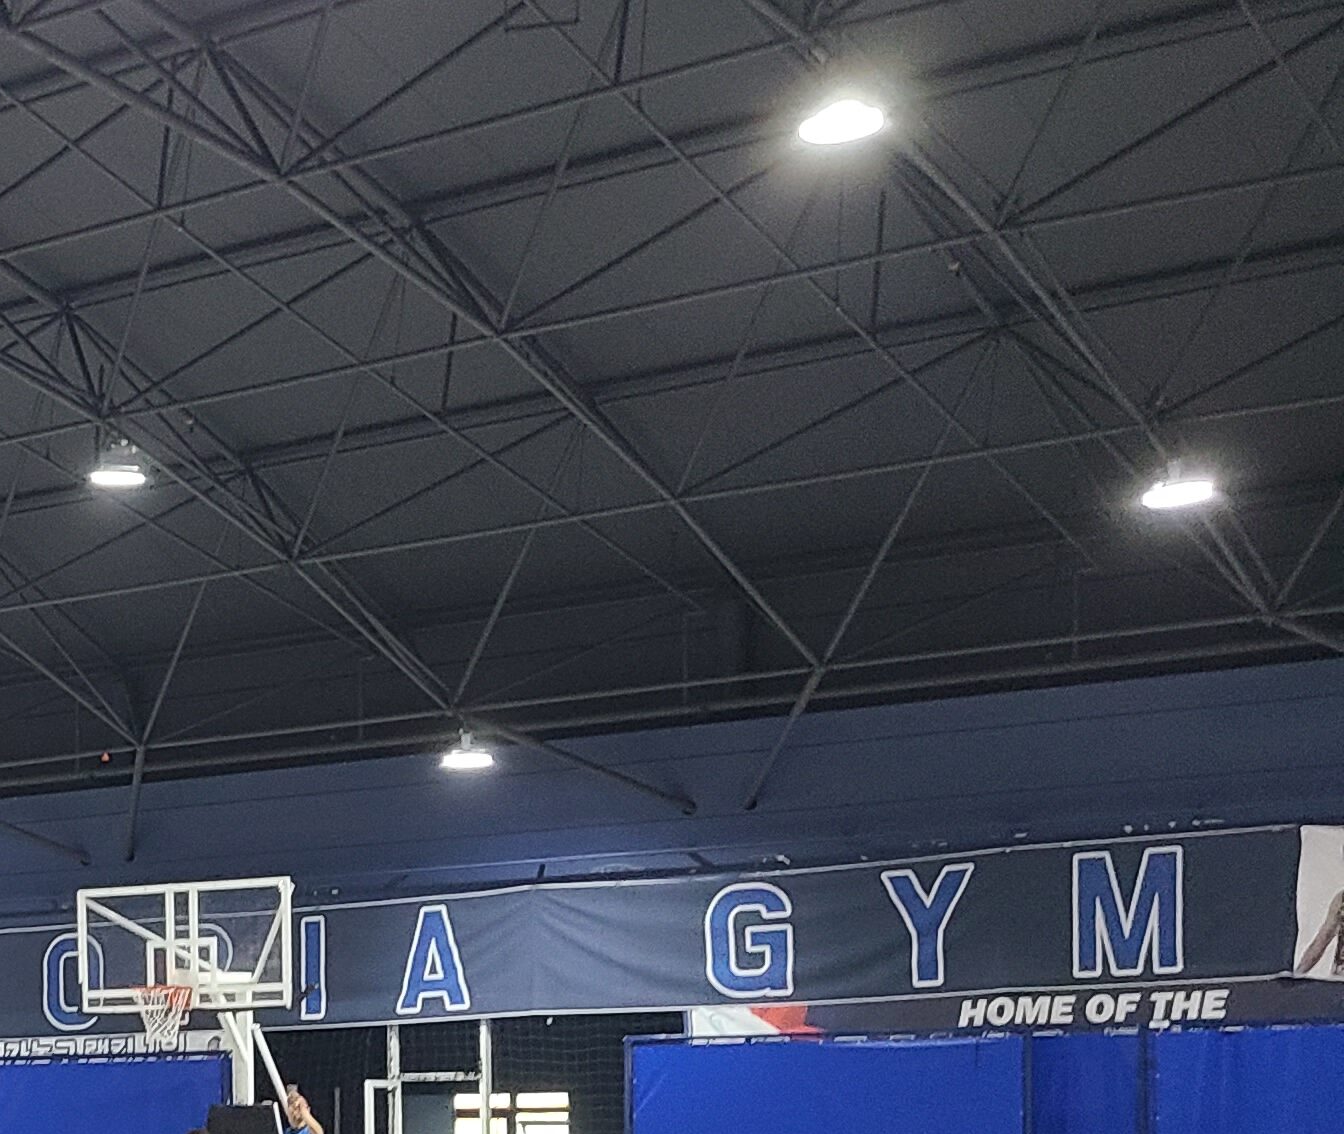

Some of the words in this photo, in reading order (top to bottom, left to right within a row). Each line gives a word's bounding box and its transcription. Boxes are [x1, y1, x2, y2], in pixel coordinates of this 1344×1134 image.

[704, 844, 1185, 998] GYM
[958, 995, 1075, 1028] HOME
[1085, 992, 1139, 1025] OF
[1149, 989, 1231, 1021] THE
